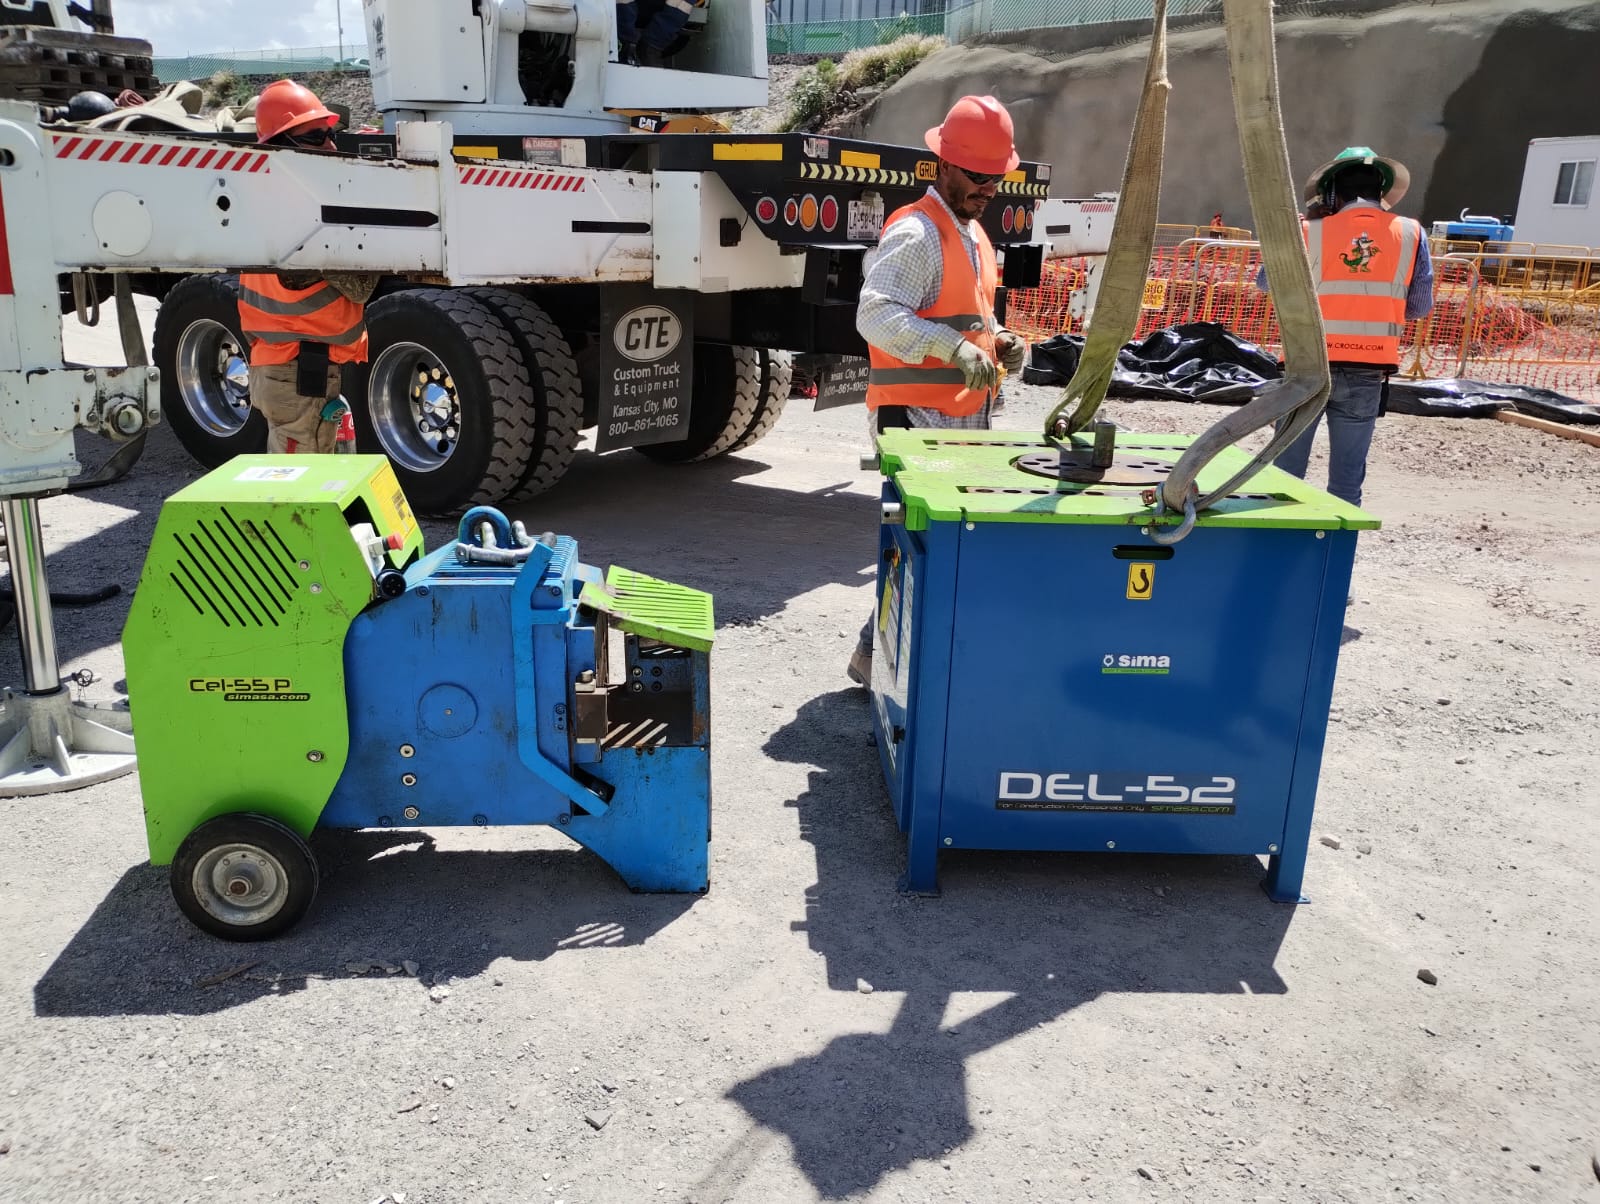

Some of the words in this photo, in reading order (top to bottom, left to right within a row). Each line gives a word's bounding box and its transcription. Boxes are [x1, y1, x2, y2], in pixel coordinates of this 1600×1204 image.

[638, 116, 658, 131] CAT
[919, 162, 936, 179] GRU
[624, 316, 671, 351] CTE
[613, 366, 651, 381] Custom
[653, 361, 681, 377] Truck
[614, 384, 621, 396] &
[624, 378, 680, 397] Equipment
[612, 404, 642, 418] Kansas
[643, 400, 660, 415] City,
[662, 397, 678, 410] MO
[608, 413, 679, 437] 800-861-1065
[1118, 654, 1171, 668] sima
[189, 678, 270, 692] Cel-55
[274, 679, 291, 692] P
[227, 693, 308, 701] simasa.com
[998, 772, 1236, 804] DEL-52
